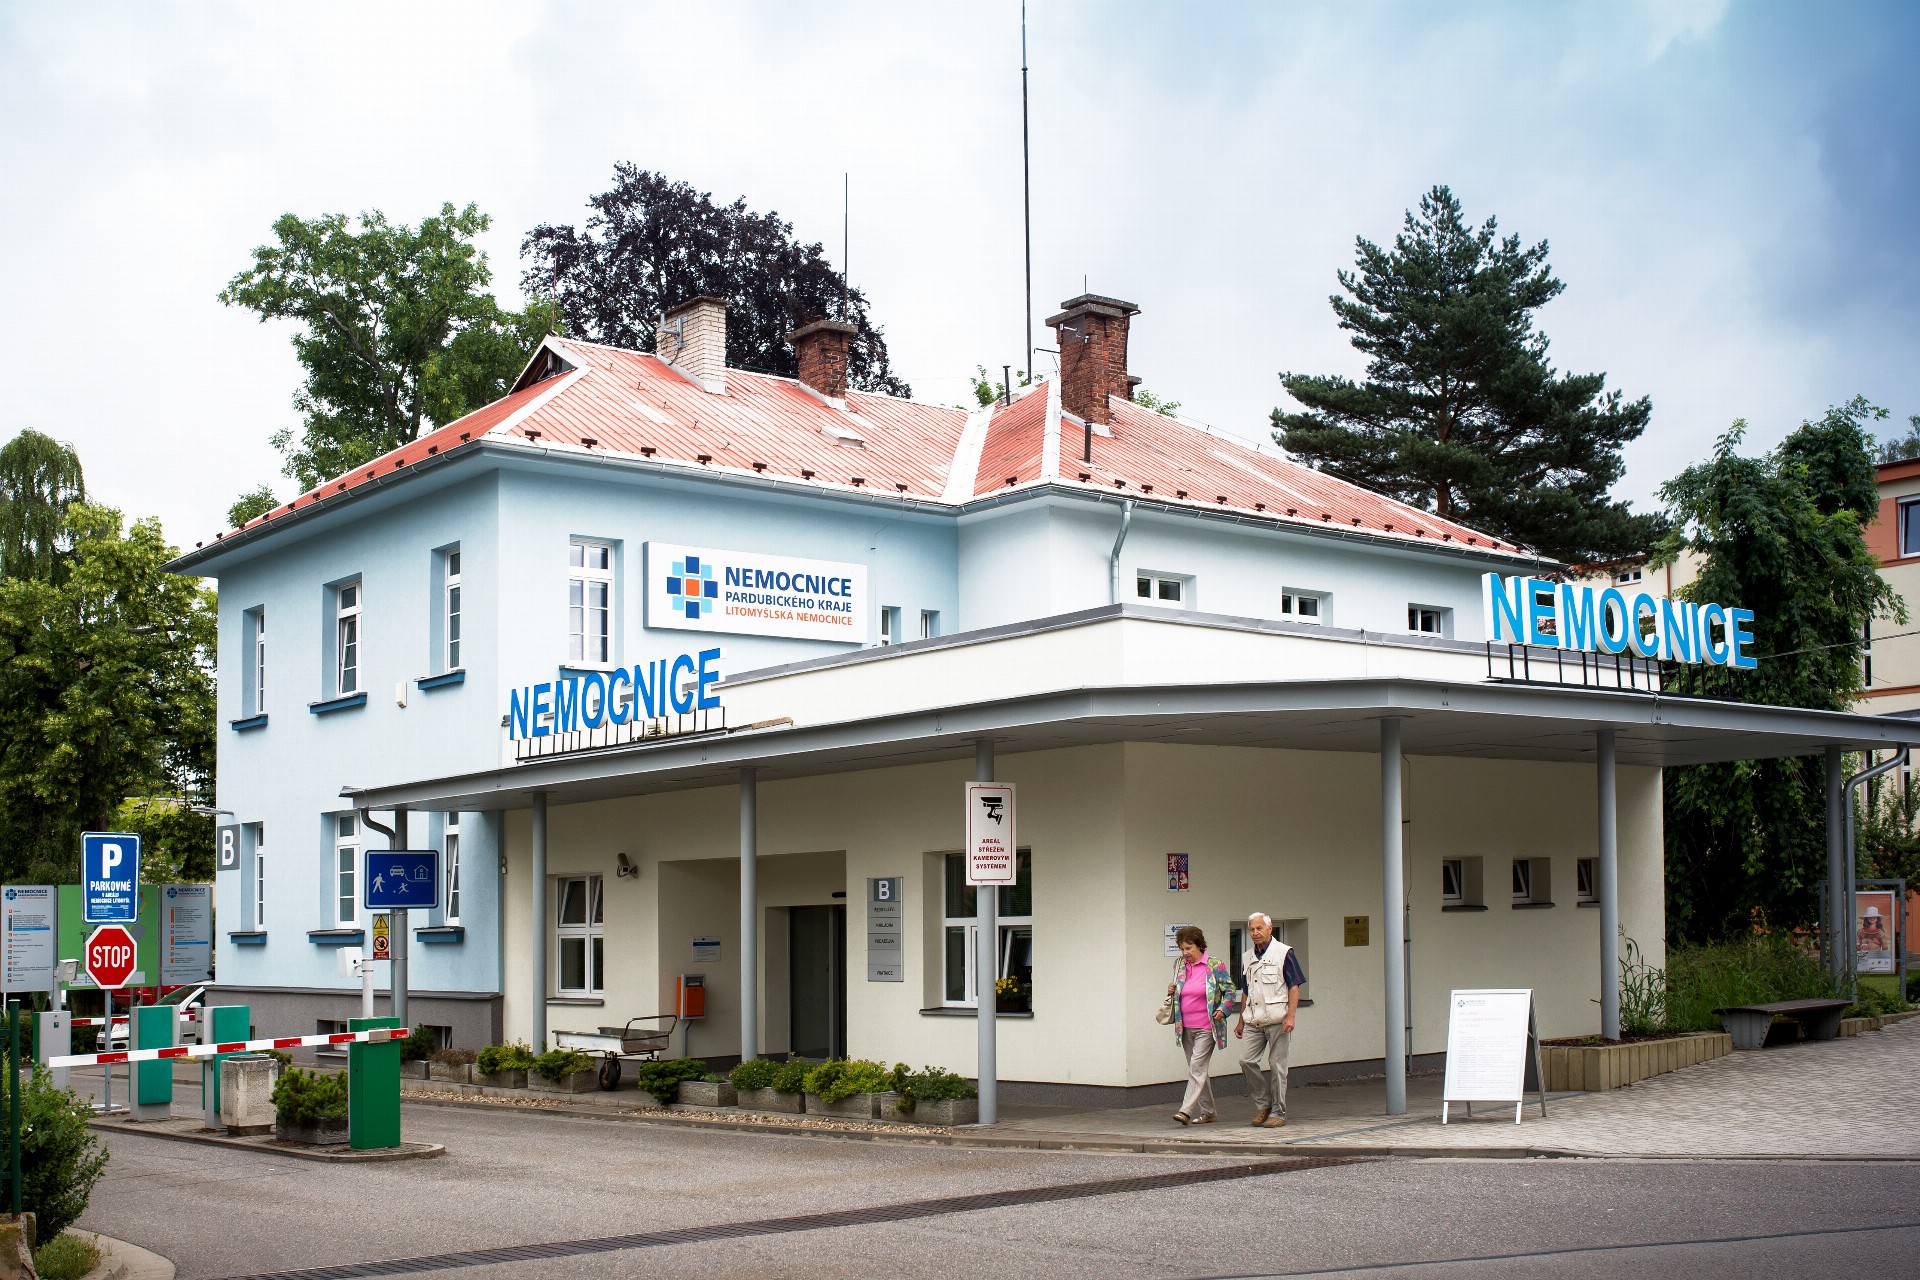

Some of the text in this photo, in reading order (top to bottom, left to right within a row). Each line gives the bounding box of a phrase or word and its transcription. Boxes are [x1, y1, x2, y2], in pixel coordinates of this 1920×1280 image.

[725, 566, 852, 597] NEMOCNICE
[725, 591, 852, 612] PARDUBICKÉHO KRAJE
[725, 606, 853, 626] LITOMYŠLSKÁ NEMOCNICE
[1482, 572, 1758, 669] NEMOCNICE
[510, 648, 724, 741] NEMOCNICE
[102, 843, 122, 879] P
[222, 829, 234, 866] B
[90, 879, 132, 892] PARKOVNÉ
[878, 880, 890, 900] B
[92, 945, 131, 969] STOP
